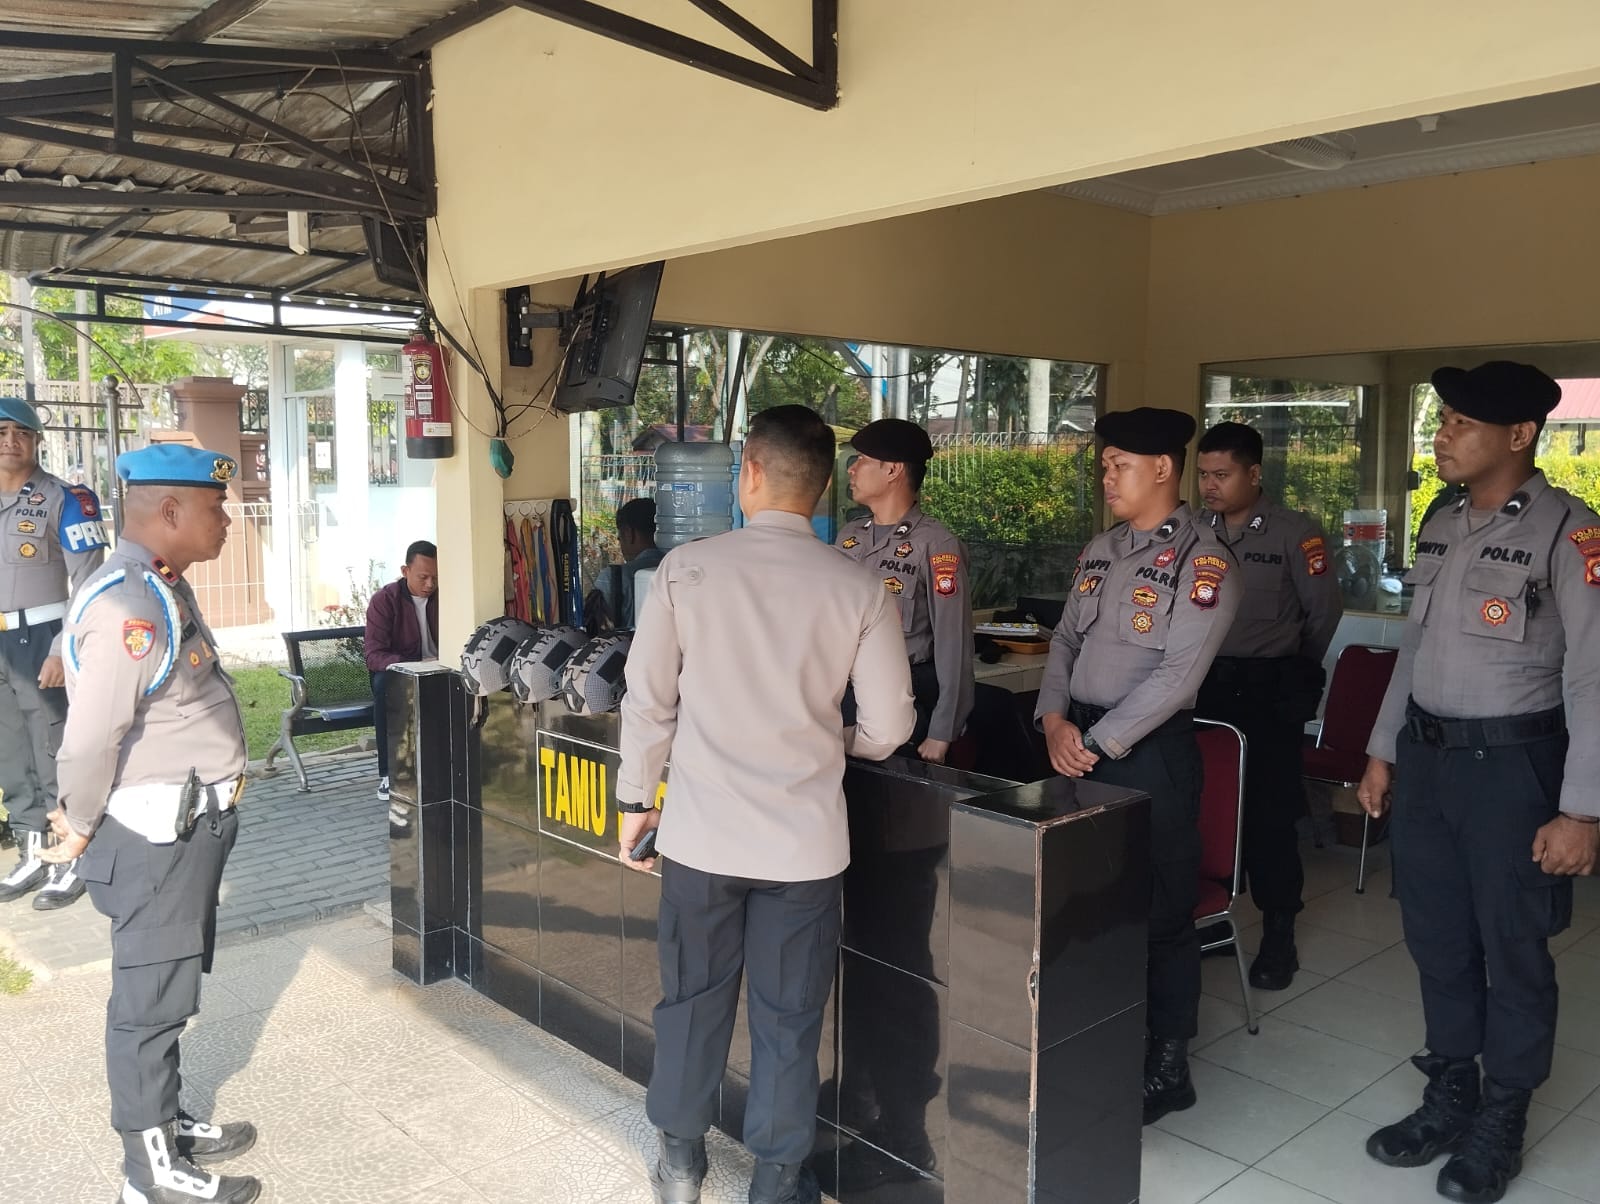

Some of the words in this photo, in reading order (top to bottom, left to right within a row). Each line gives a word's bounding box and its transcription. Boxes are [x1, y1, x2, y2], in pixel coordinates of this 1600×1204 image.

[15, 508, 48, 518] POLRI
[1244, 551, 1283, 565] POLRI
[1480, 546, 1533, 566] POLRI
[879, 559, 916, 575] POLRI
[1135, 566, 1176, 588] POLRI
[540, 746, 607, 837] TAMU
